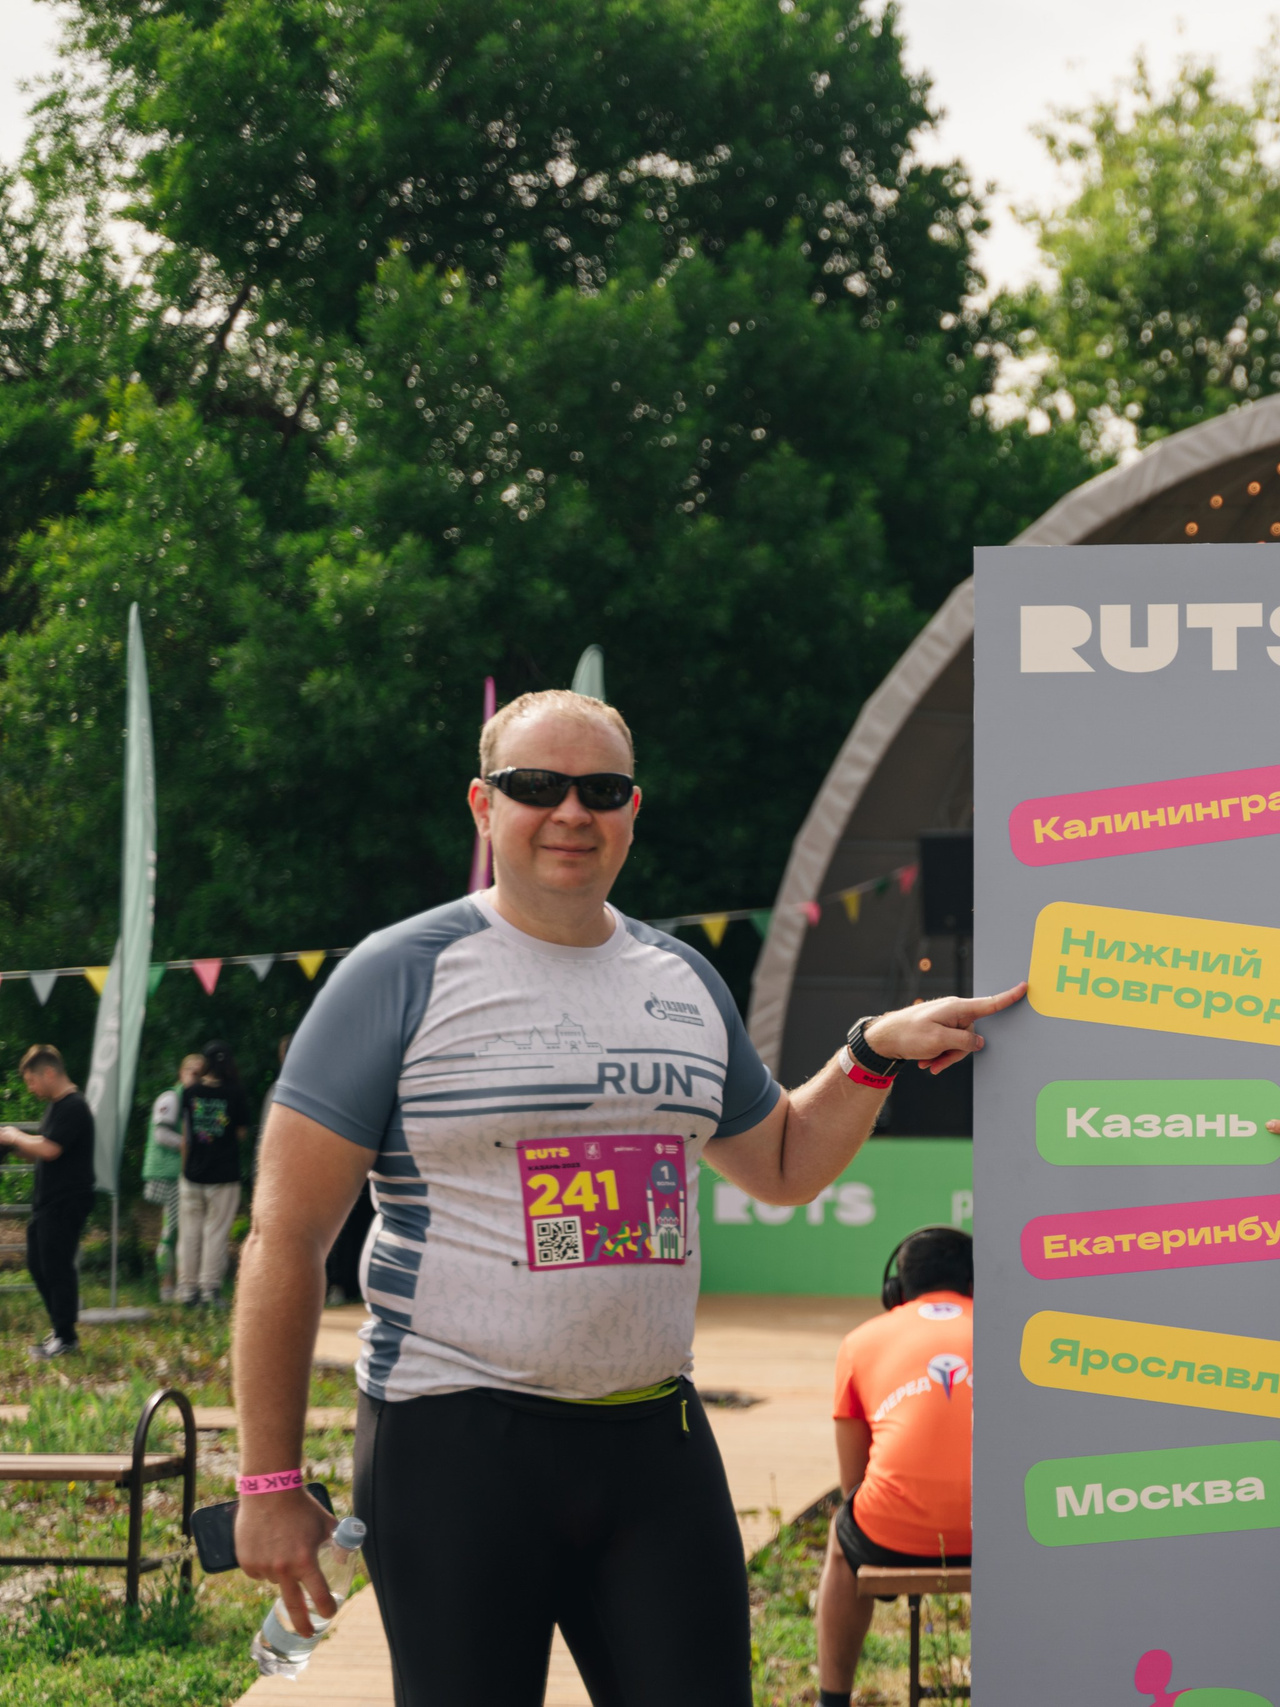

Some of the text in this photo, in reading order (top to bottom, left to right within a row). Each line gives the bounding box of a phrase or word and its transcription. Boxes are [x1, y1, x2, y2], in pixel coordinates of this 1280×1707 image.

[1060, 927, 1263, 979] Нижний
[597, 1062, 694, 1097] RUN
[1065, 1107, 1258, 1138] Казань
[525, 1147, 570, 1160] RUTS
[660, 1165, 669, 1180] 1
[527, 1170, 620, 1217] 241
[1055, 1476, 1265, 1517] Москва
